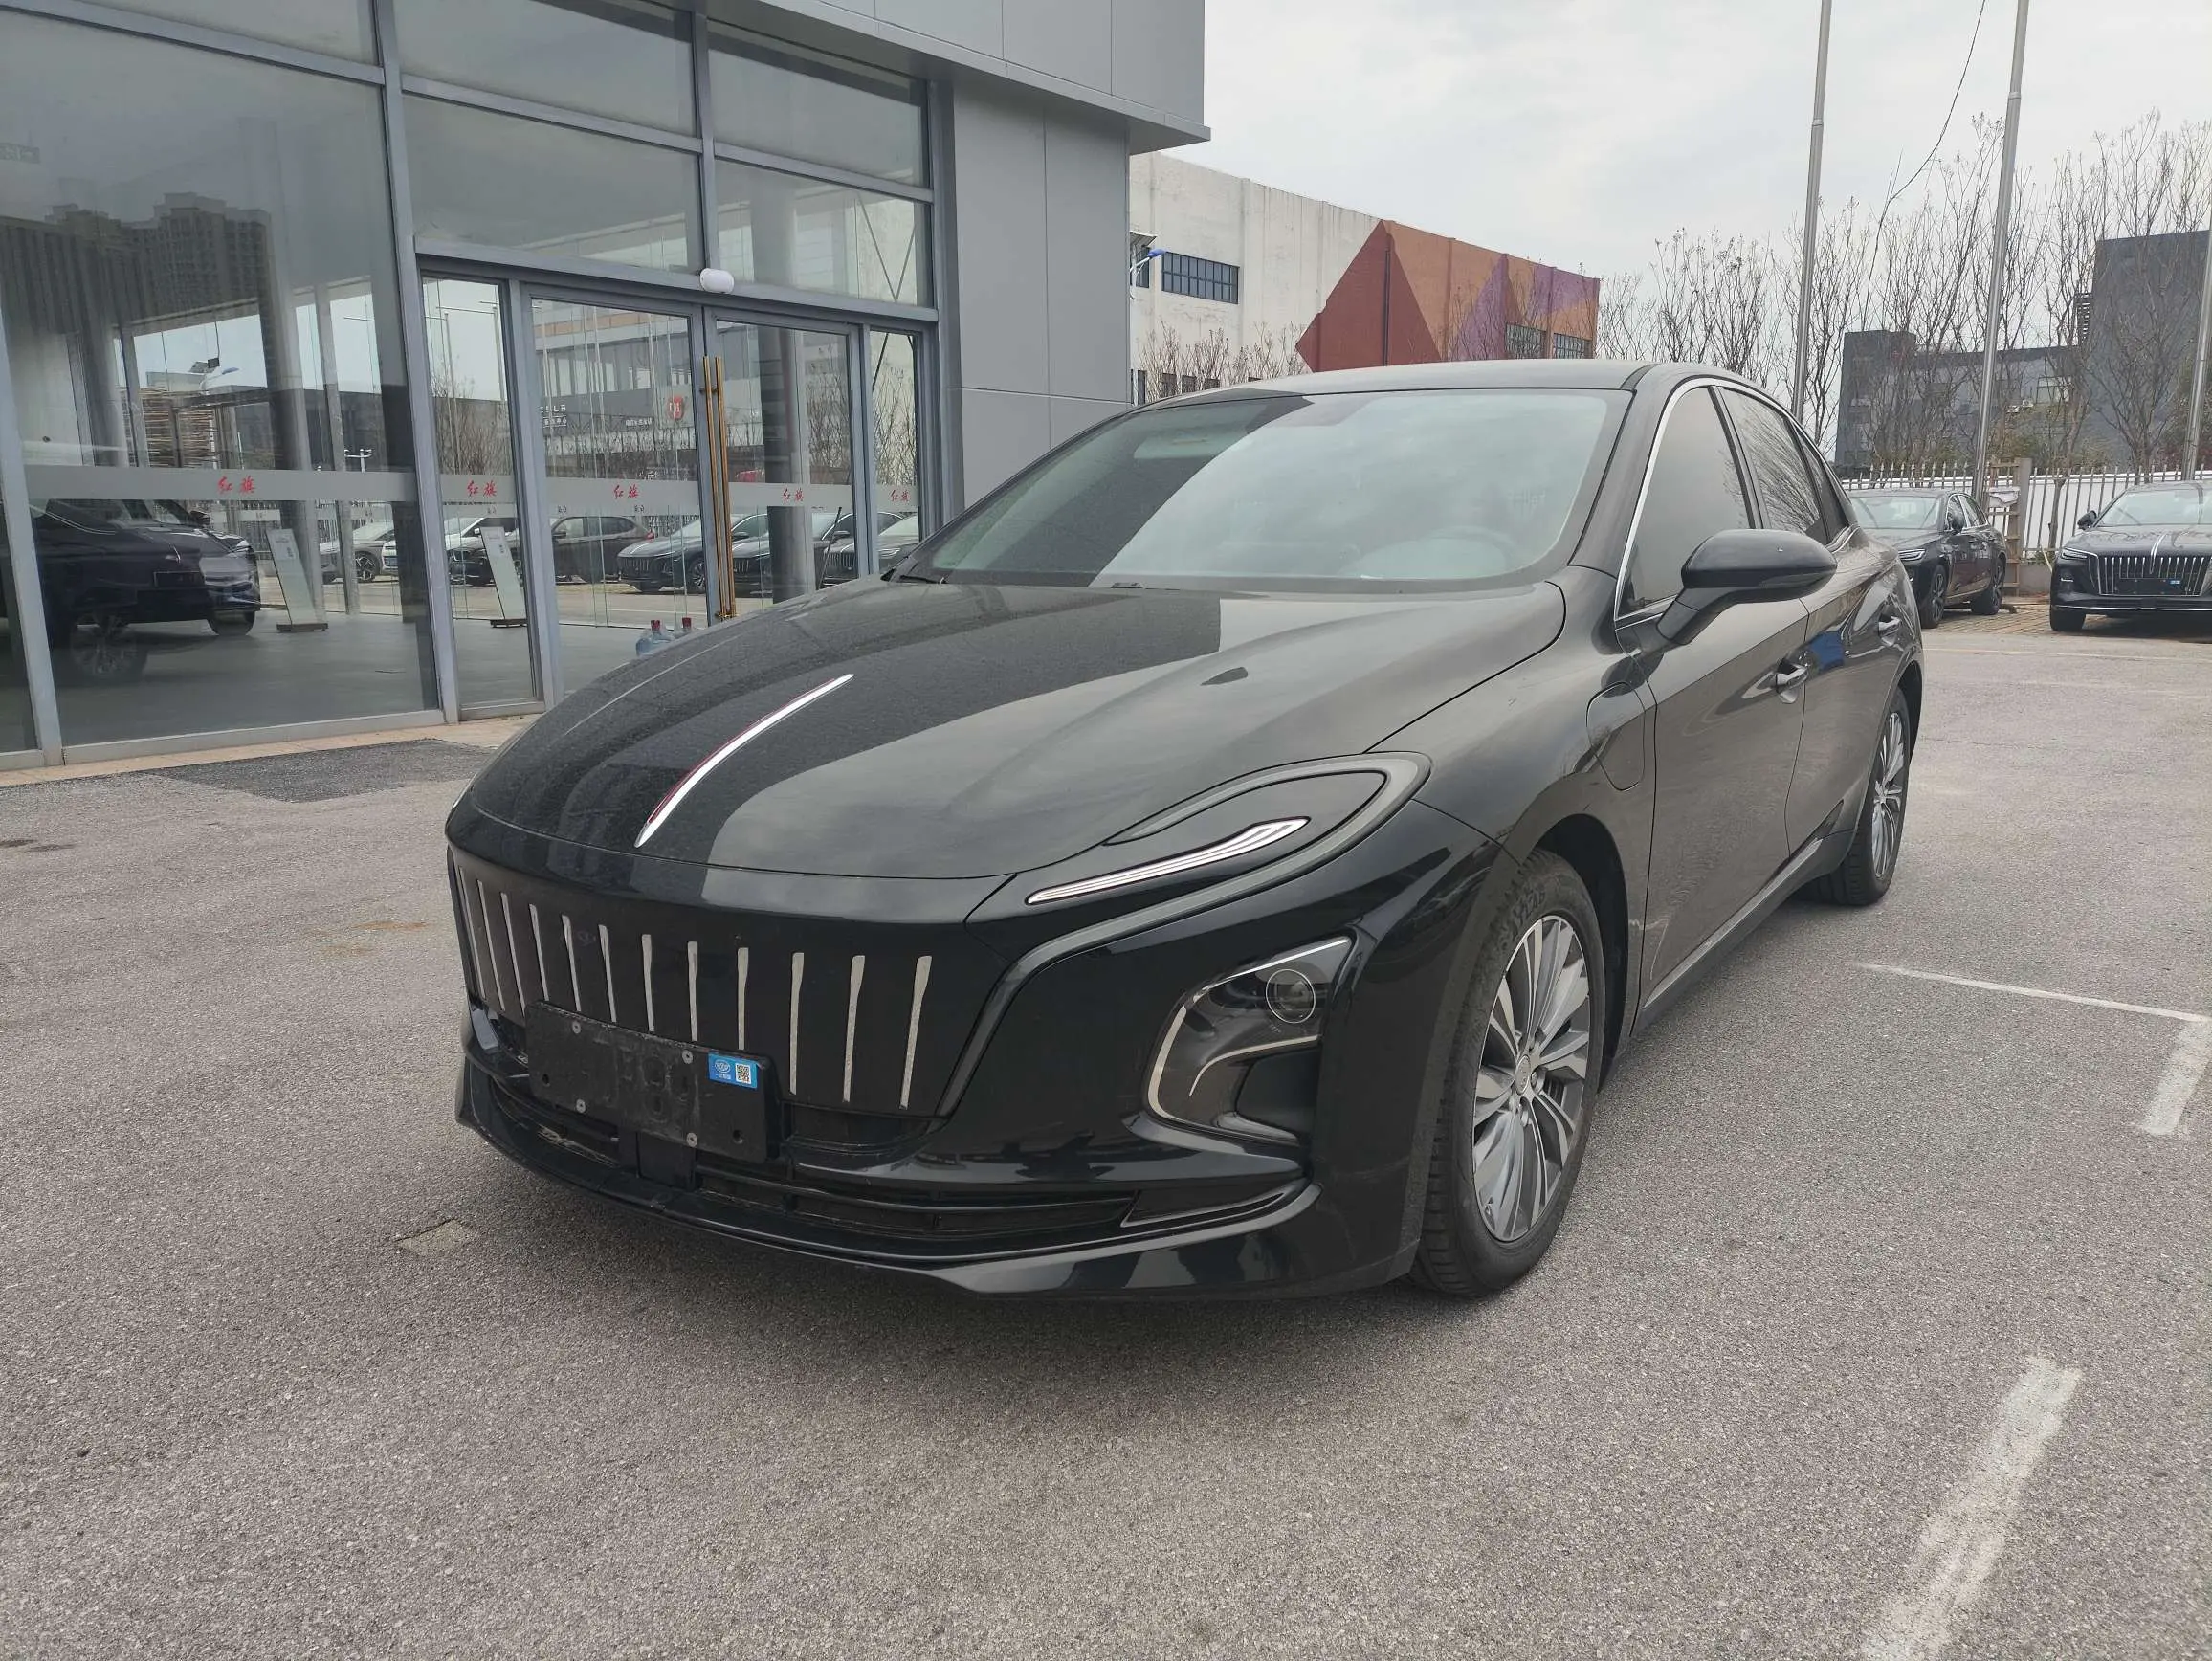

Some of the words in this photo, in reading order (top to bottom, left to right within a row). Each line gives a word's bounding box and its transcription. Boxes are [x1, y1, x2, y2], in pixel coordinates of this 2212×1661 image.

[217, 476, 254, 495] 红旗
[467, 479, 497, 498] 红旗
[613, 483, 639, 499] 红旗
